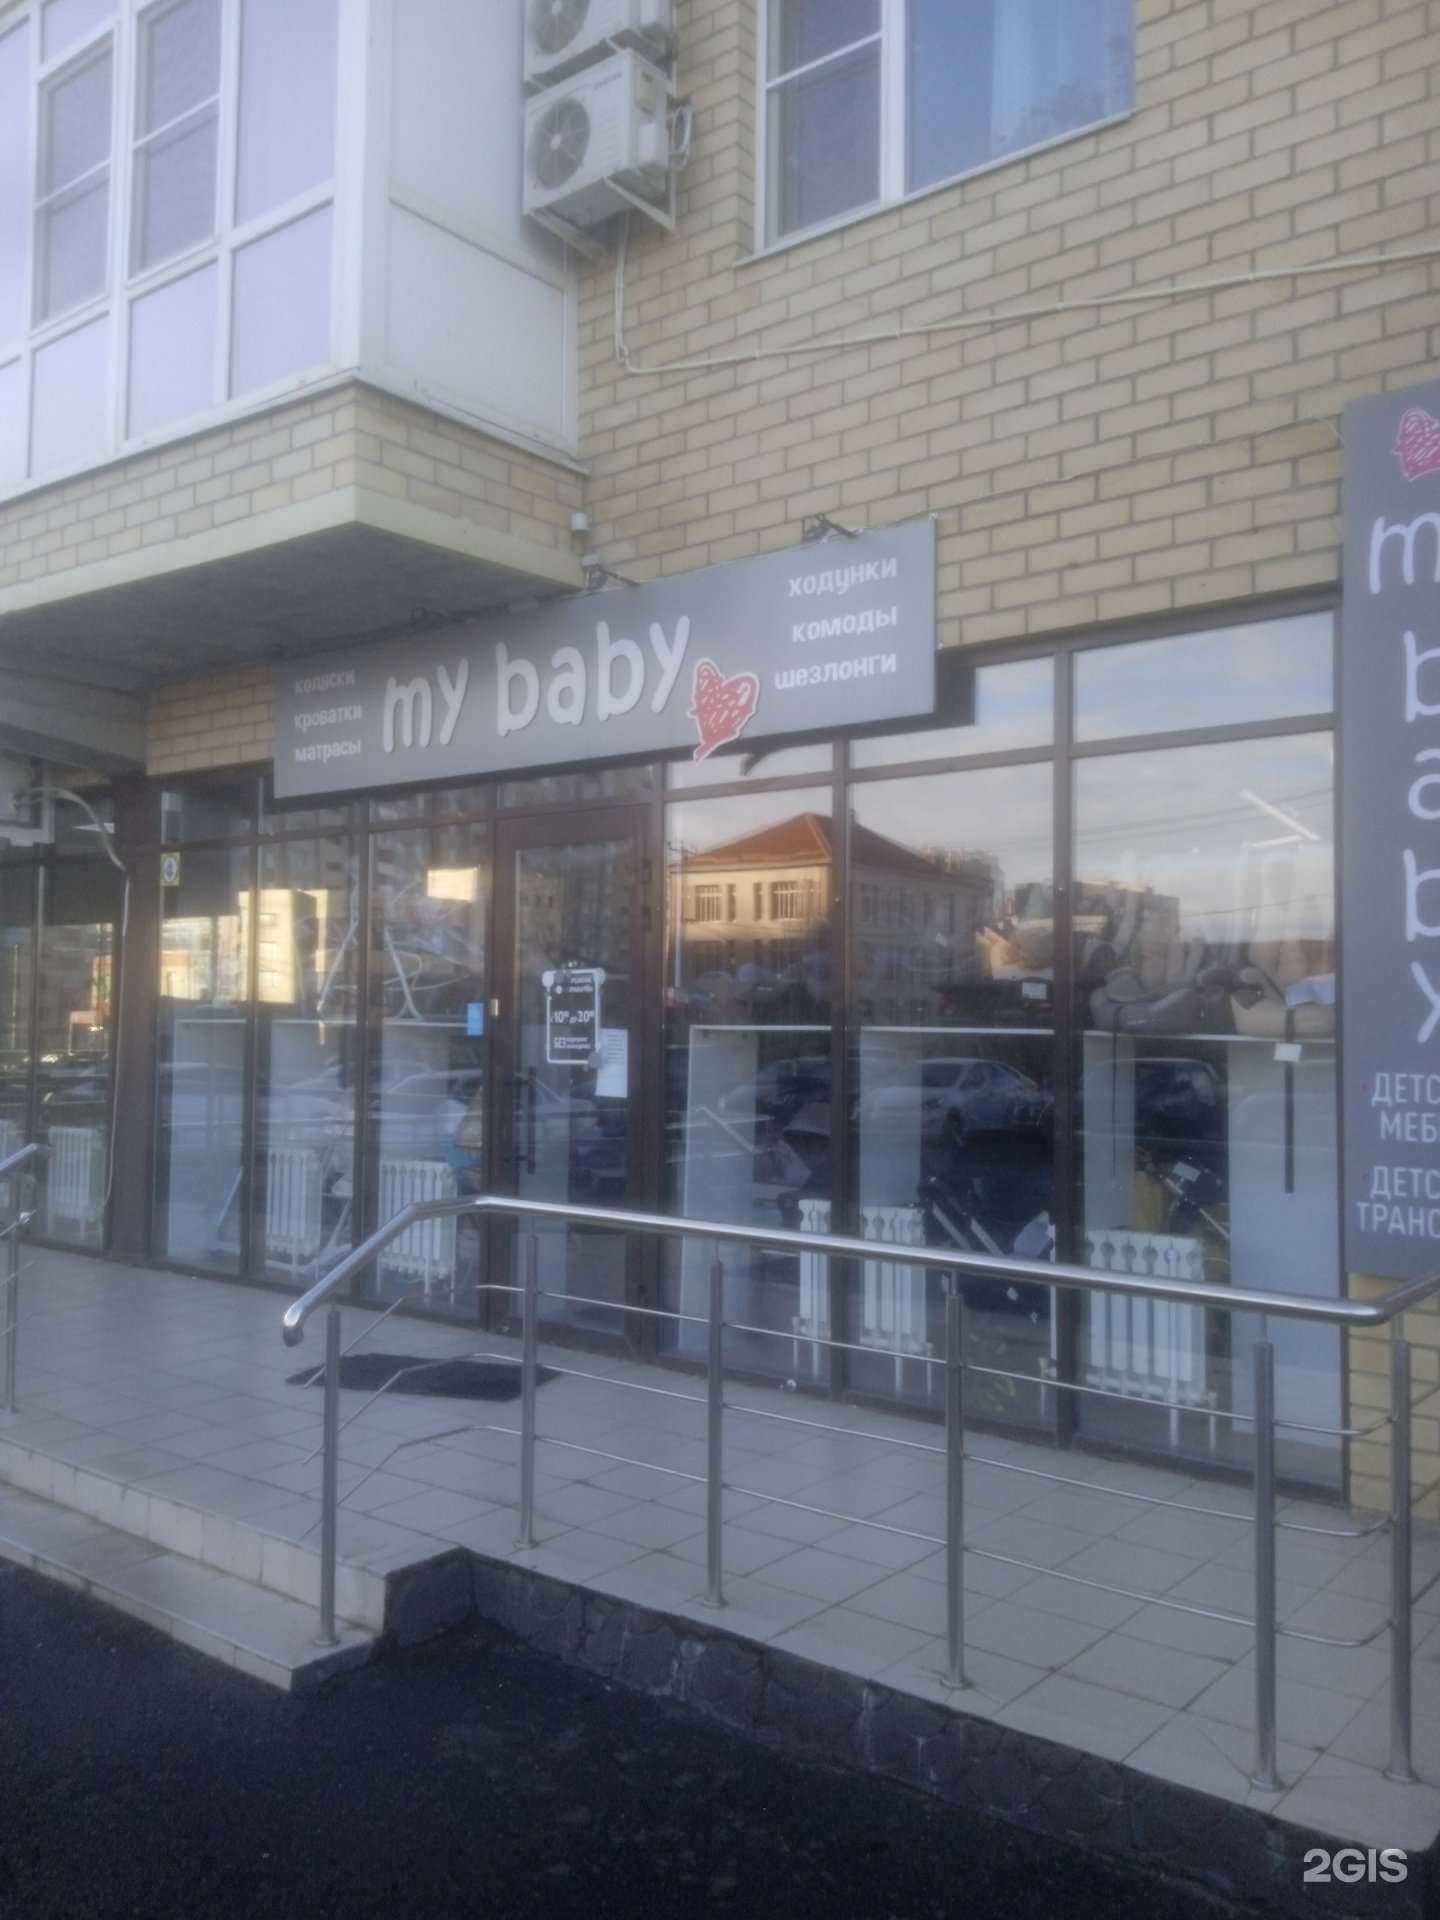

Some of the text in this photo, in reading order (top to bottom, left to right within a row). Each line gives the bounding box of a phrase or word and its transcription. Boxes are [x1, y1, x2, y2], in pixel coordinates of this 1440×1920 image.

[788, 557, 898, 597] ходунки
[791, 606, 898, 643] комоды
[383, 615, 691, 754] my baby
[773, 653, 898, 691] шезлонги
[294, 703, 364, 734] кроватки
[294, 738, 362, 764] матрасы
